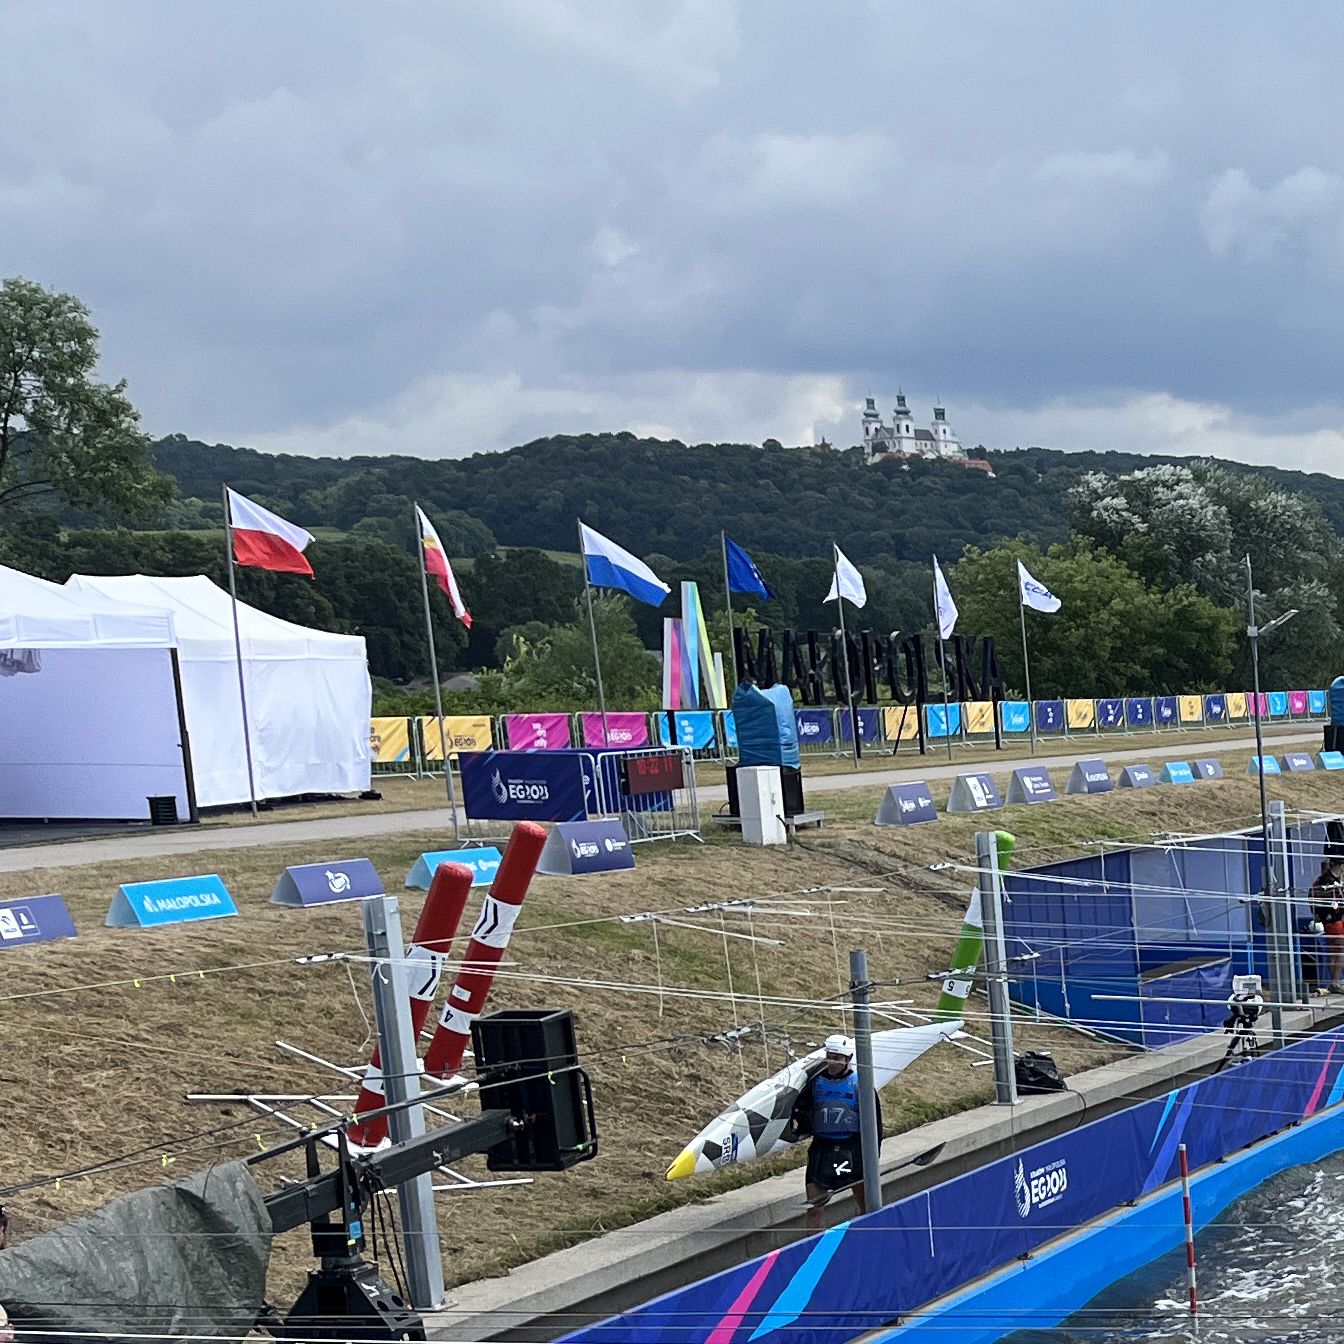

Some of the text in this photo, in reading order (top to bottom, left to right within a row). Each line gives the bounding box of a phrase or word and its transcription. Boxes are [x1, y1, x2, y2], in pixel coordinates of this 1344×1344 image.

[508, 784, 549, 800] EG2023
[156, 892, 222, 912] MAŁOPOLSKA
[1031, 1168, 1067, 1204] EG2023
